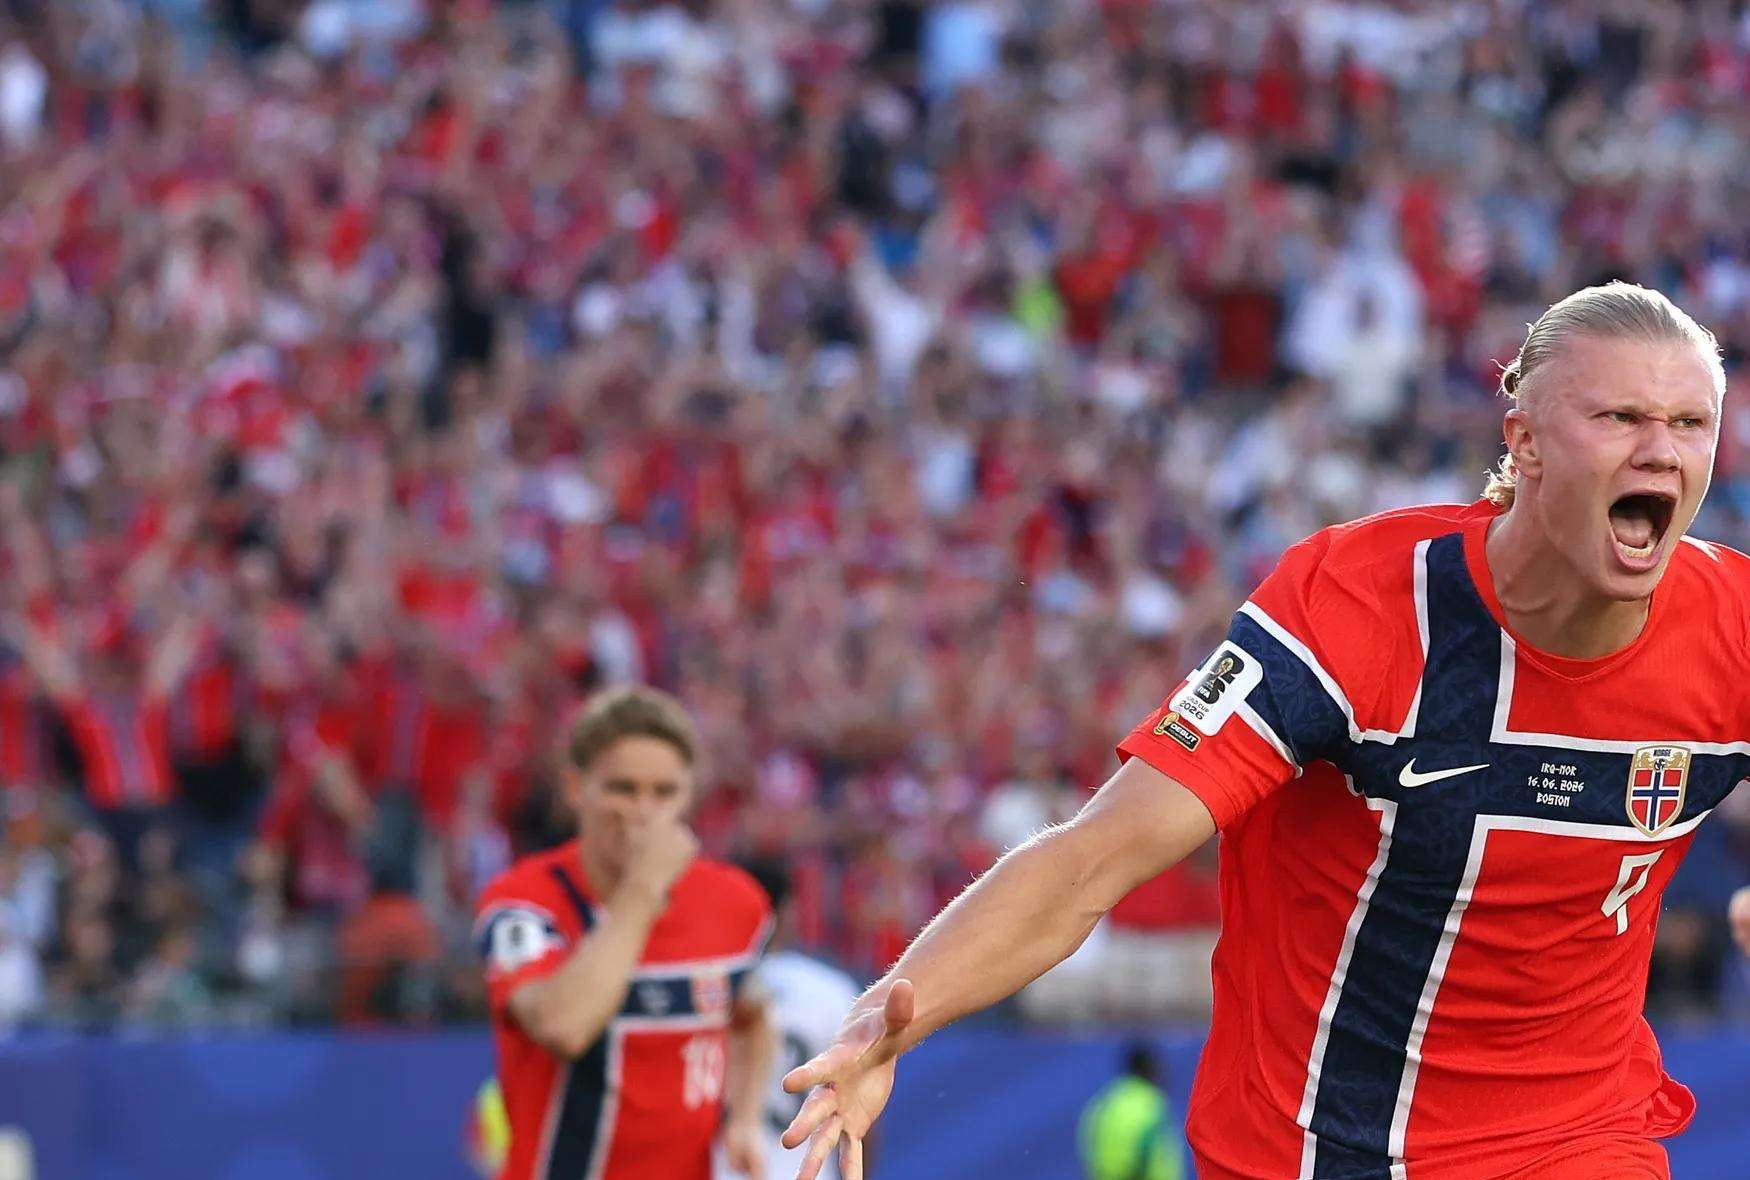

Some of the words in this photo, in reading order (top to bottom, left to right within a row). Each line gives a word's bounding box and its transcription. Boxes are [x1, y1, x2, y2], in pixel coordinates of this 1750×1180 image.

[1180, 700, 1205, 720] 2026
[1170, 723, 1198, 743] DEBUT
[1536, 792, 1570, 807] BOSTON
[1601, 849, 1664, 936] 9
